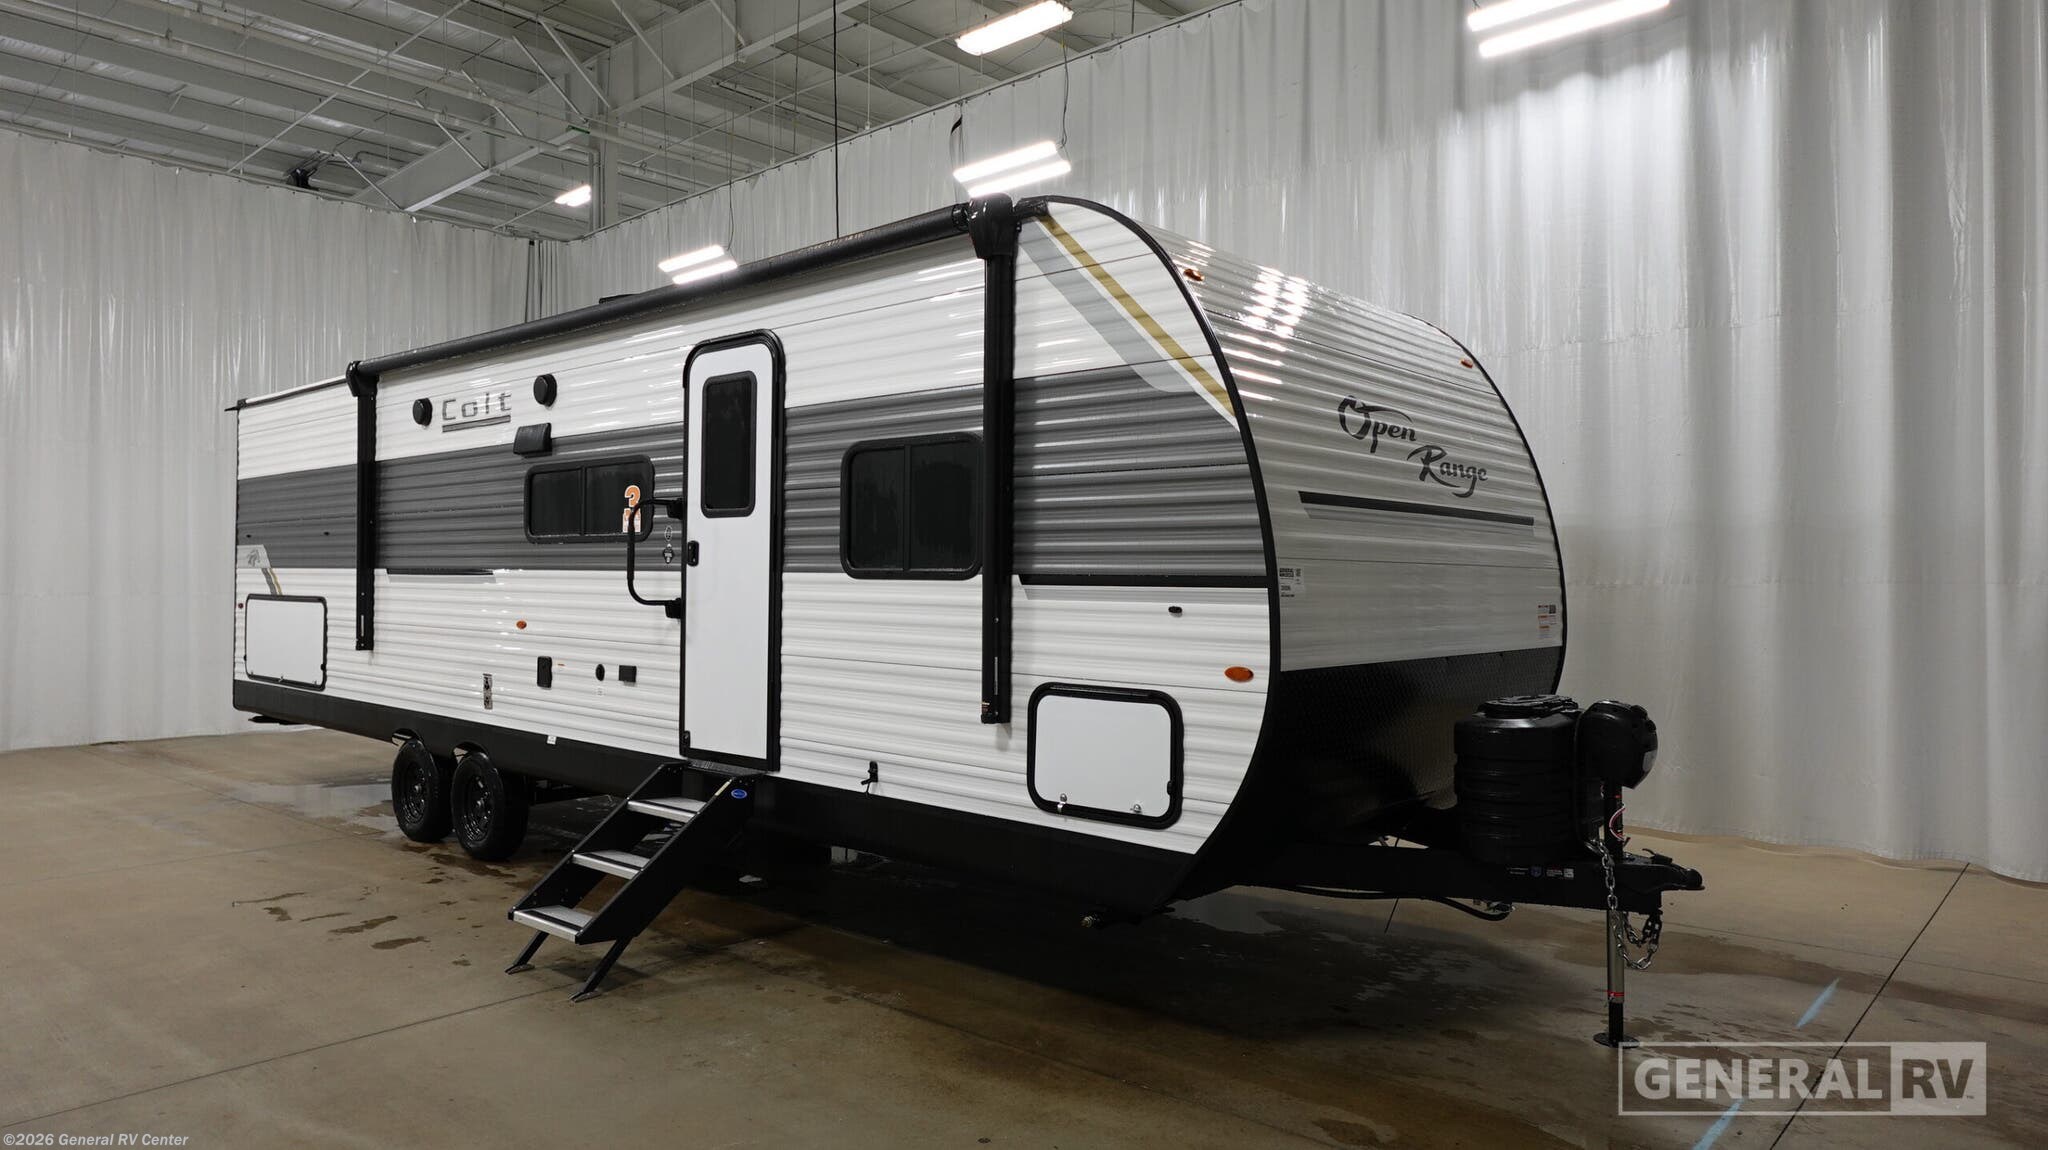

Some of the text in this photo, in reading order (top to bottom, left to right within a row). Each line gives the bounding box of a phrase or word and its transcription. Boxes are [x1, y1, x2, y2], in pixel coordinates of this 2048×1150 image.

[442, 392, 511, 420] Colt
[1338, 395, 1416, 453] Open
[1407, 445, 1488, 498] Range
